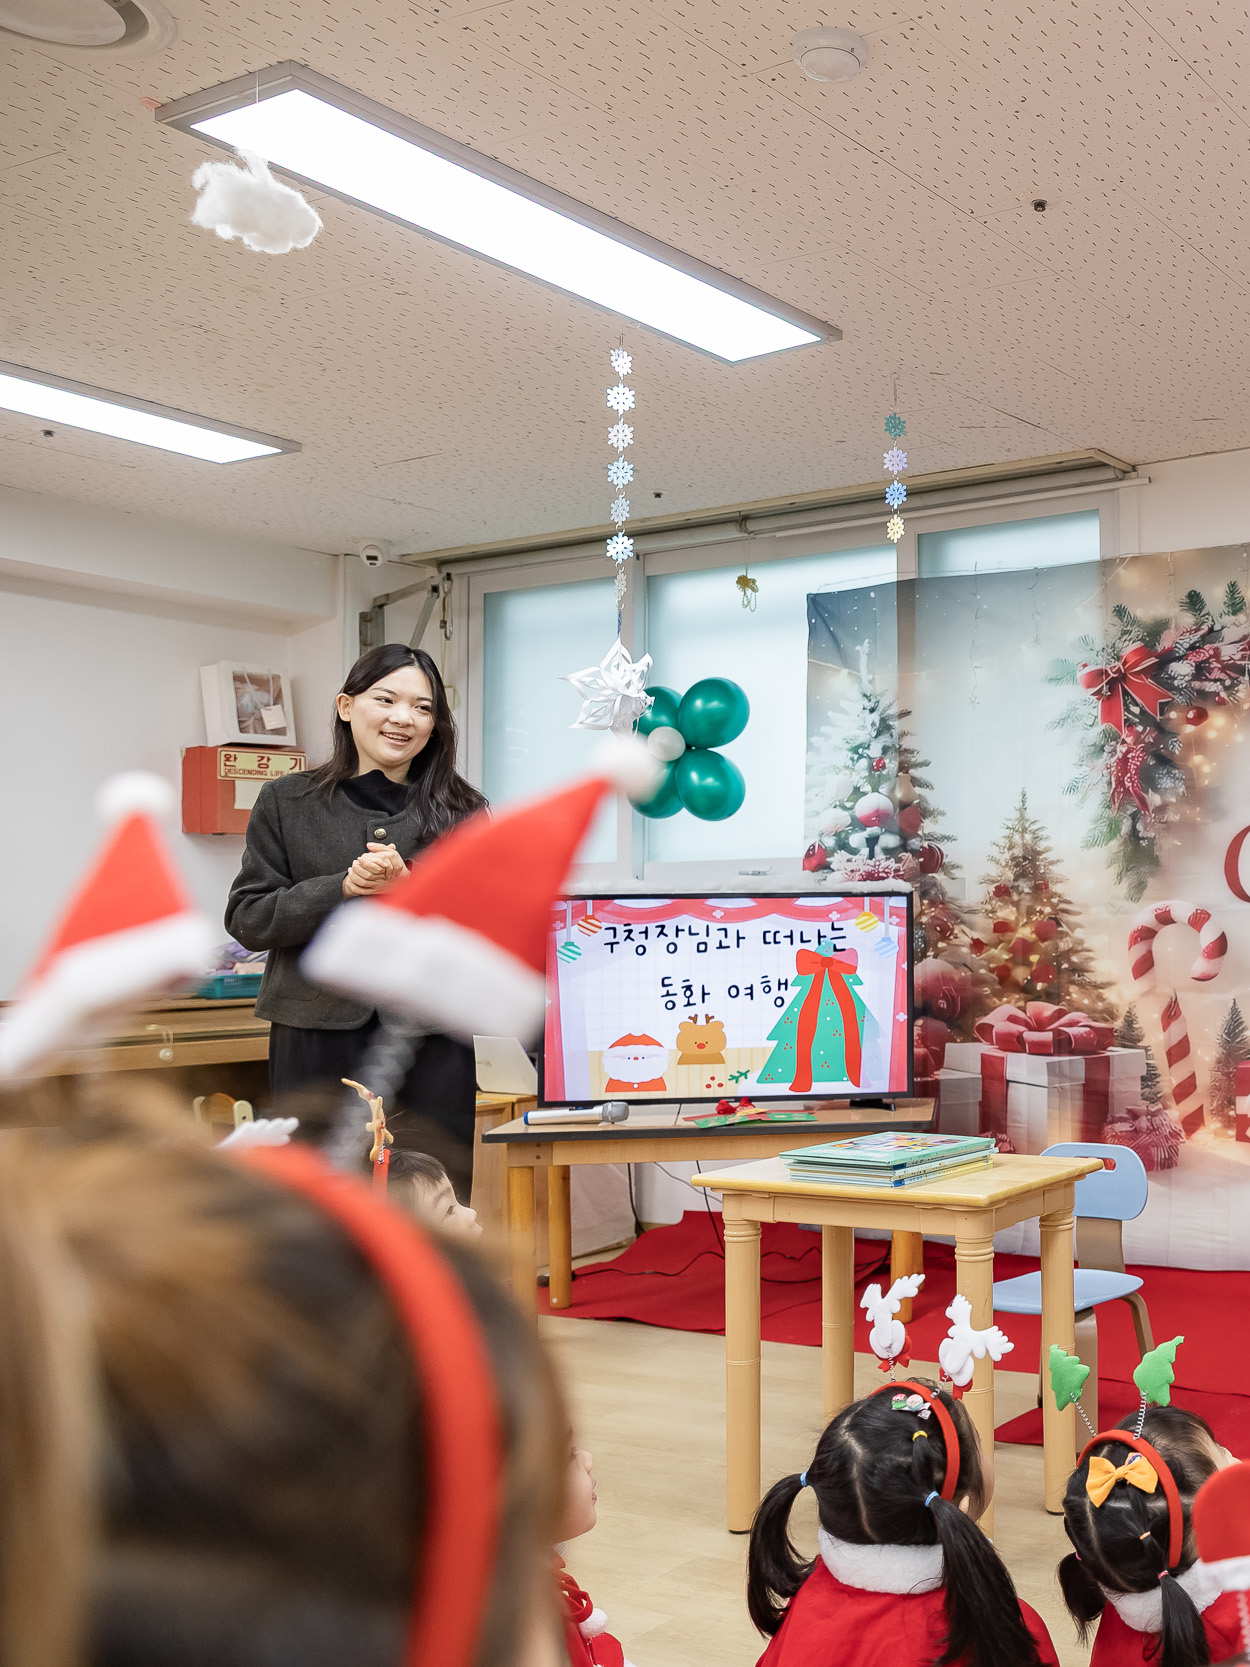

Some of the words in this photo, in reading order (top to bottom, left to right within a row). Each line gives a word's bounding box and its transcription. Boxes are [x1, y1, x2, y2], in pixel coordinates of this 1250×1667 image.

[603, 922, 746, 957] 구청장님과
[762, 921, 848, 953] 떠나는
[660, 975, 711, 1011] 동화
[727, 974, 790, 1008] 여행
